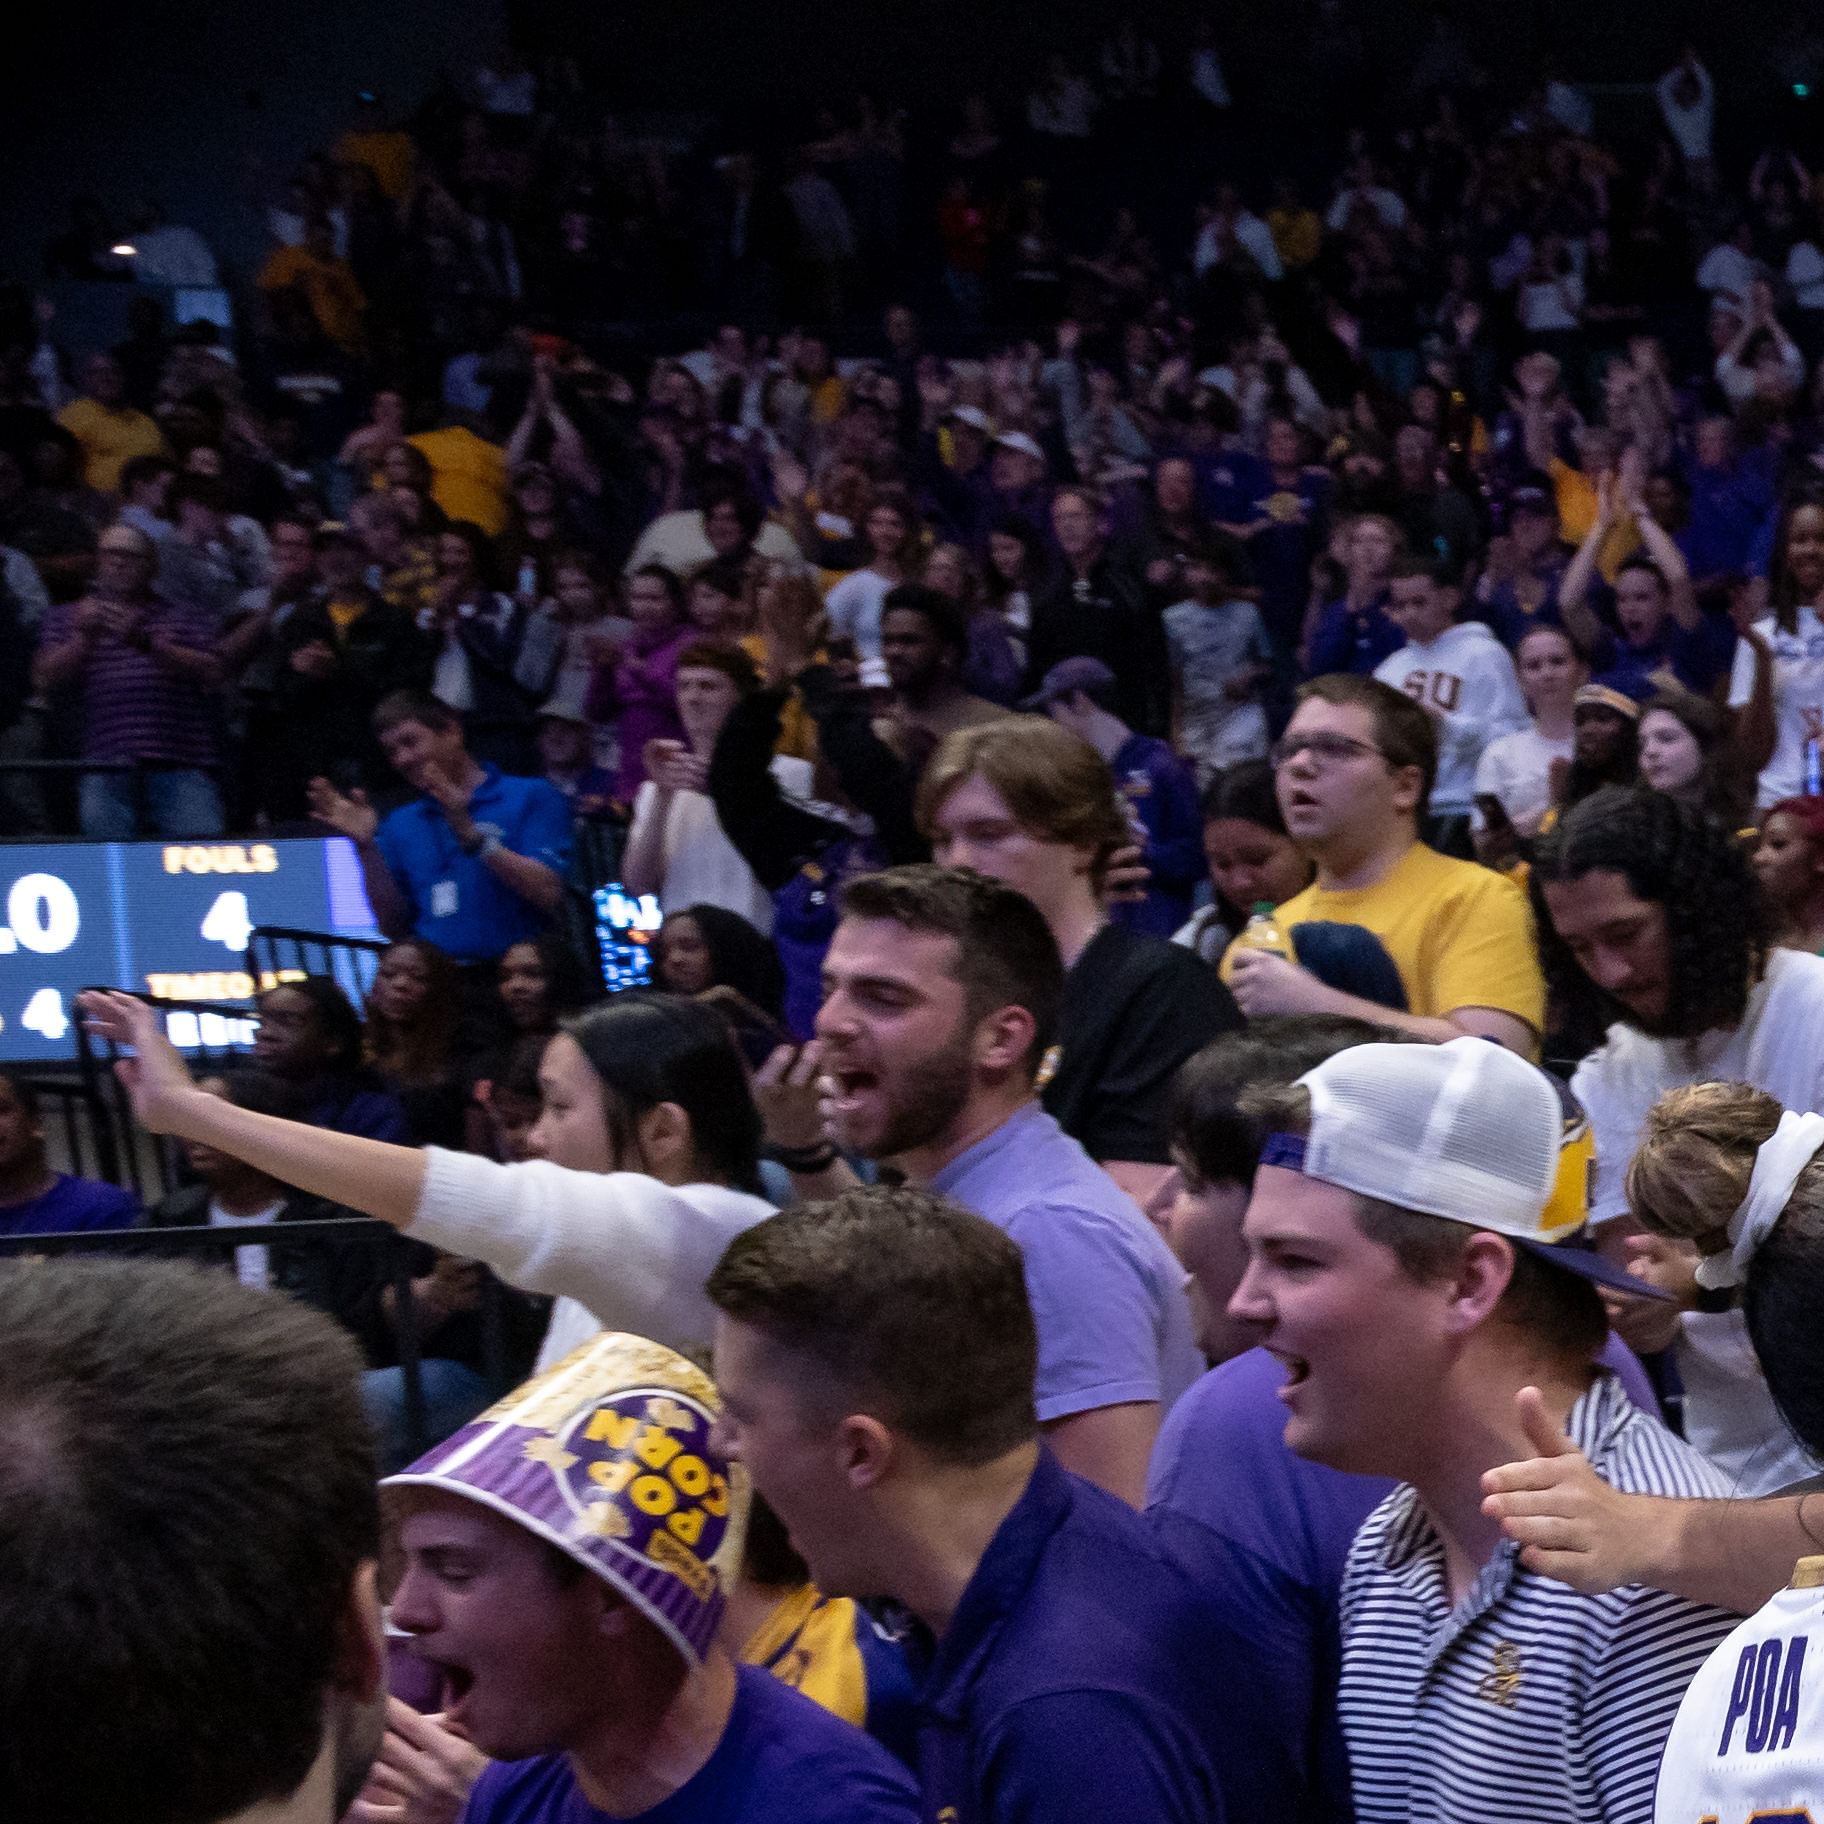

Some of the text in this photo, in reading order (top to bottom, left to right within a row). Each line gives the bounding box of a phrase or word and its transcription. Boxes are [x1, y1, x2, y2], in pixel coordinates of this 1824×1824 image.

[163, 844, 279, 875] FOULS
[201, 890, 256, 952] 4
[22, 987, 69, 1040] 4
[1717, 1635, 1809, 1758] POA
